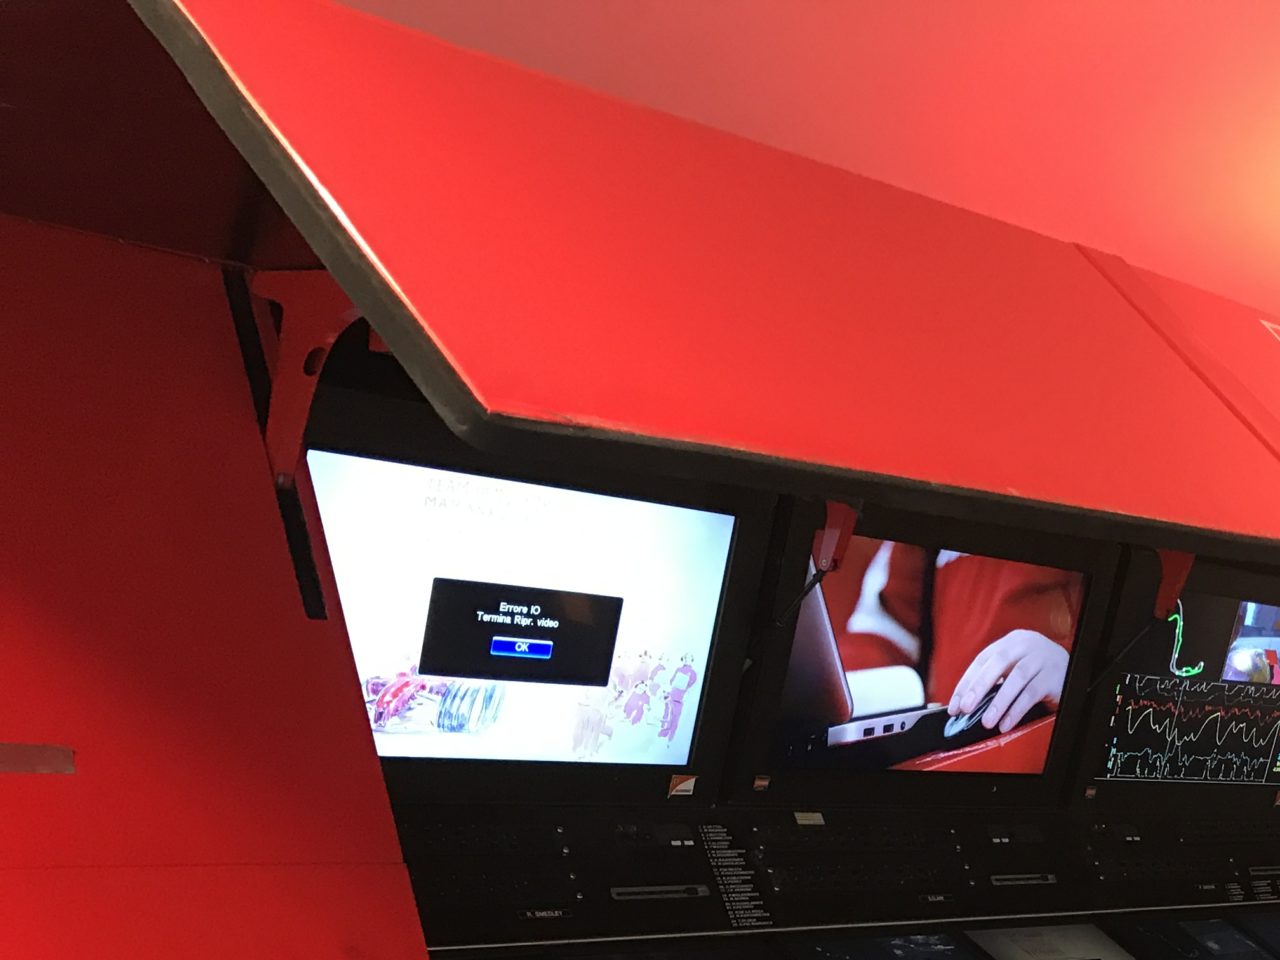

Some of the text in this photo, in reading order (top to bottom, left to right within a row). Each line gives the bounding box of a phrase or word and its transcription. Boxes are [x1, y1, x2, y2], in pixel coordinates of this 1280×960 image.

[499, 602, 528, 614] Errore
[476, 611, 511, 624] Termina
[537, 618, 559, 628] video
[515, 642, 530, 652] OK
